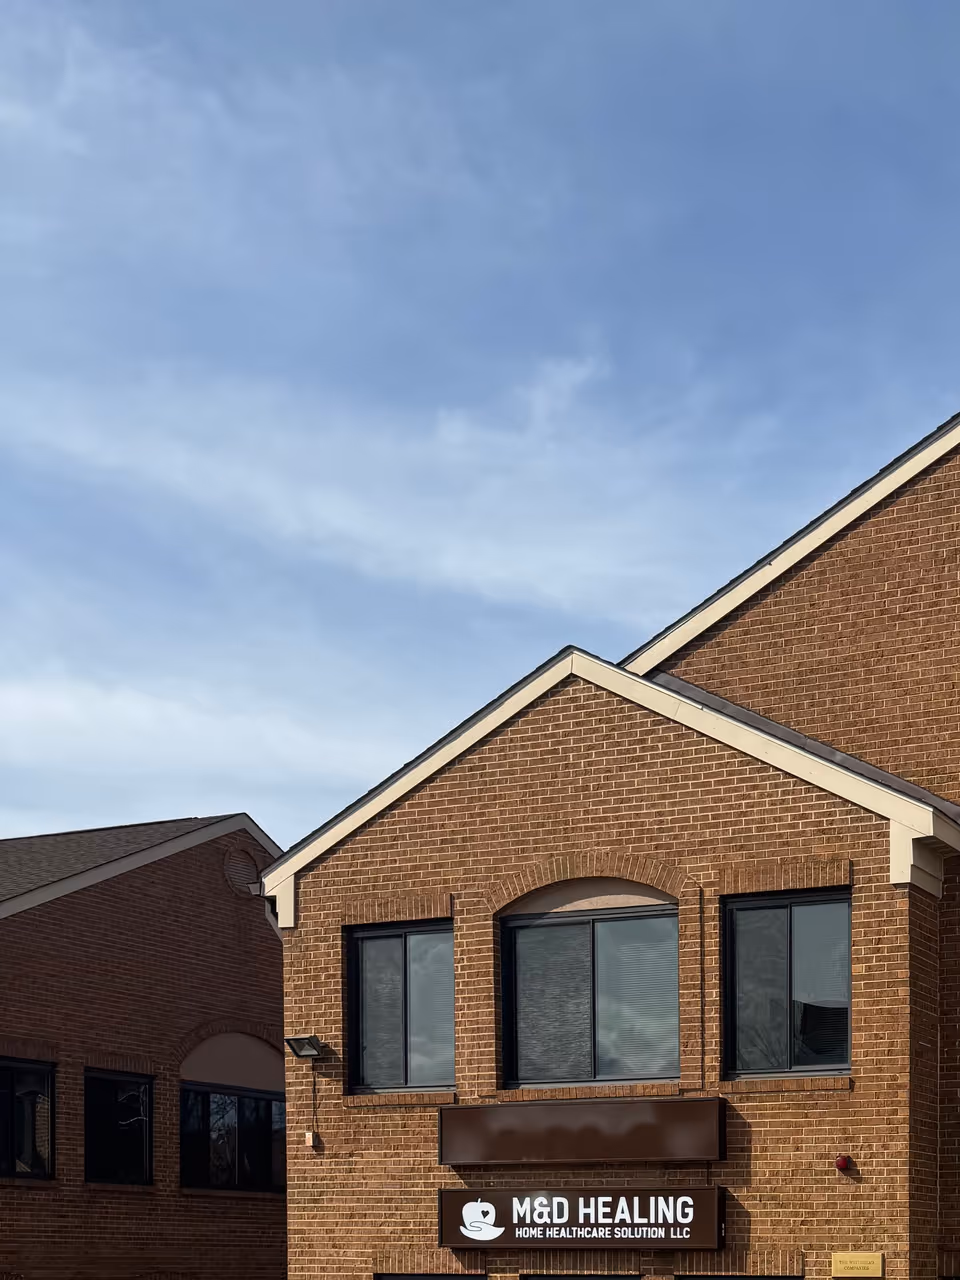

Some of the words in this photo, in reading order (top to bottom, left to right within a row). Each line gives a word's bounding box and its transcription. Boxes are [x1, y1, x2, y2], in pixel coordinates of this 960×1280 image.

[512, 1196, 570, 1224] M&D
[578, 1196, 694, 1224] HEALING
[515, 1227, 544, 1239] HOME
[546, 1227, 612, 1239] HEALTHCARE
[614, 1226, 665, 1239] SOLUTION
[670, 1226, 691, 1238] LLC
